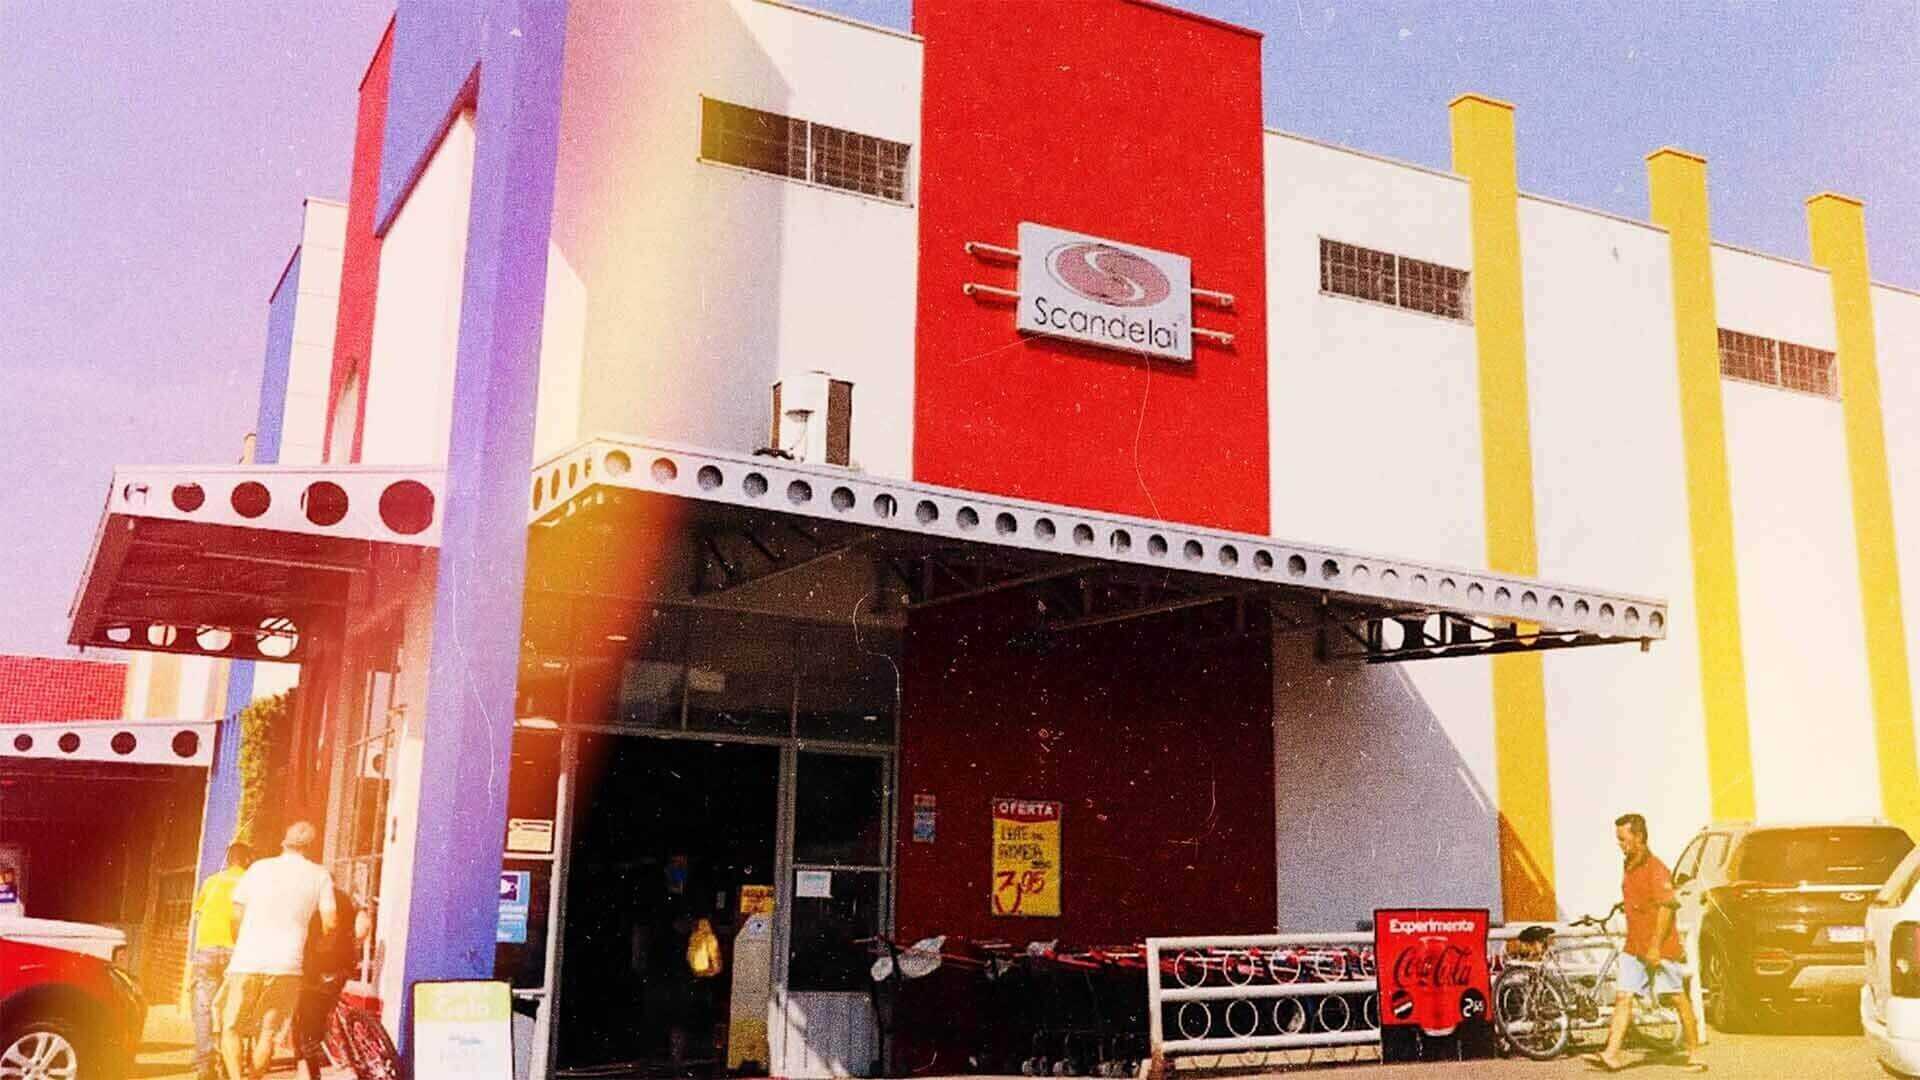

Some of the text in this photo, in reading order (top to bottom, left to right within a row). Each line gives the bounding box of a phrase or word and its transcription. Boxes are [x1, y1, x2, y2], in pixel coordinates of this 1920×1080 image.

[1034, 296, 1178, 349] Scandelai
[999, 802, 1054, 816] OFERTA
[1389, 918, 1475, 935] Experimente
